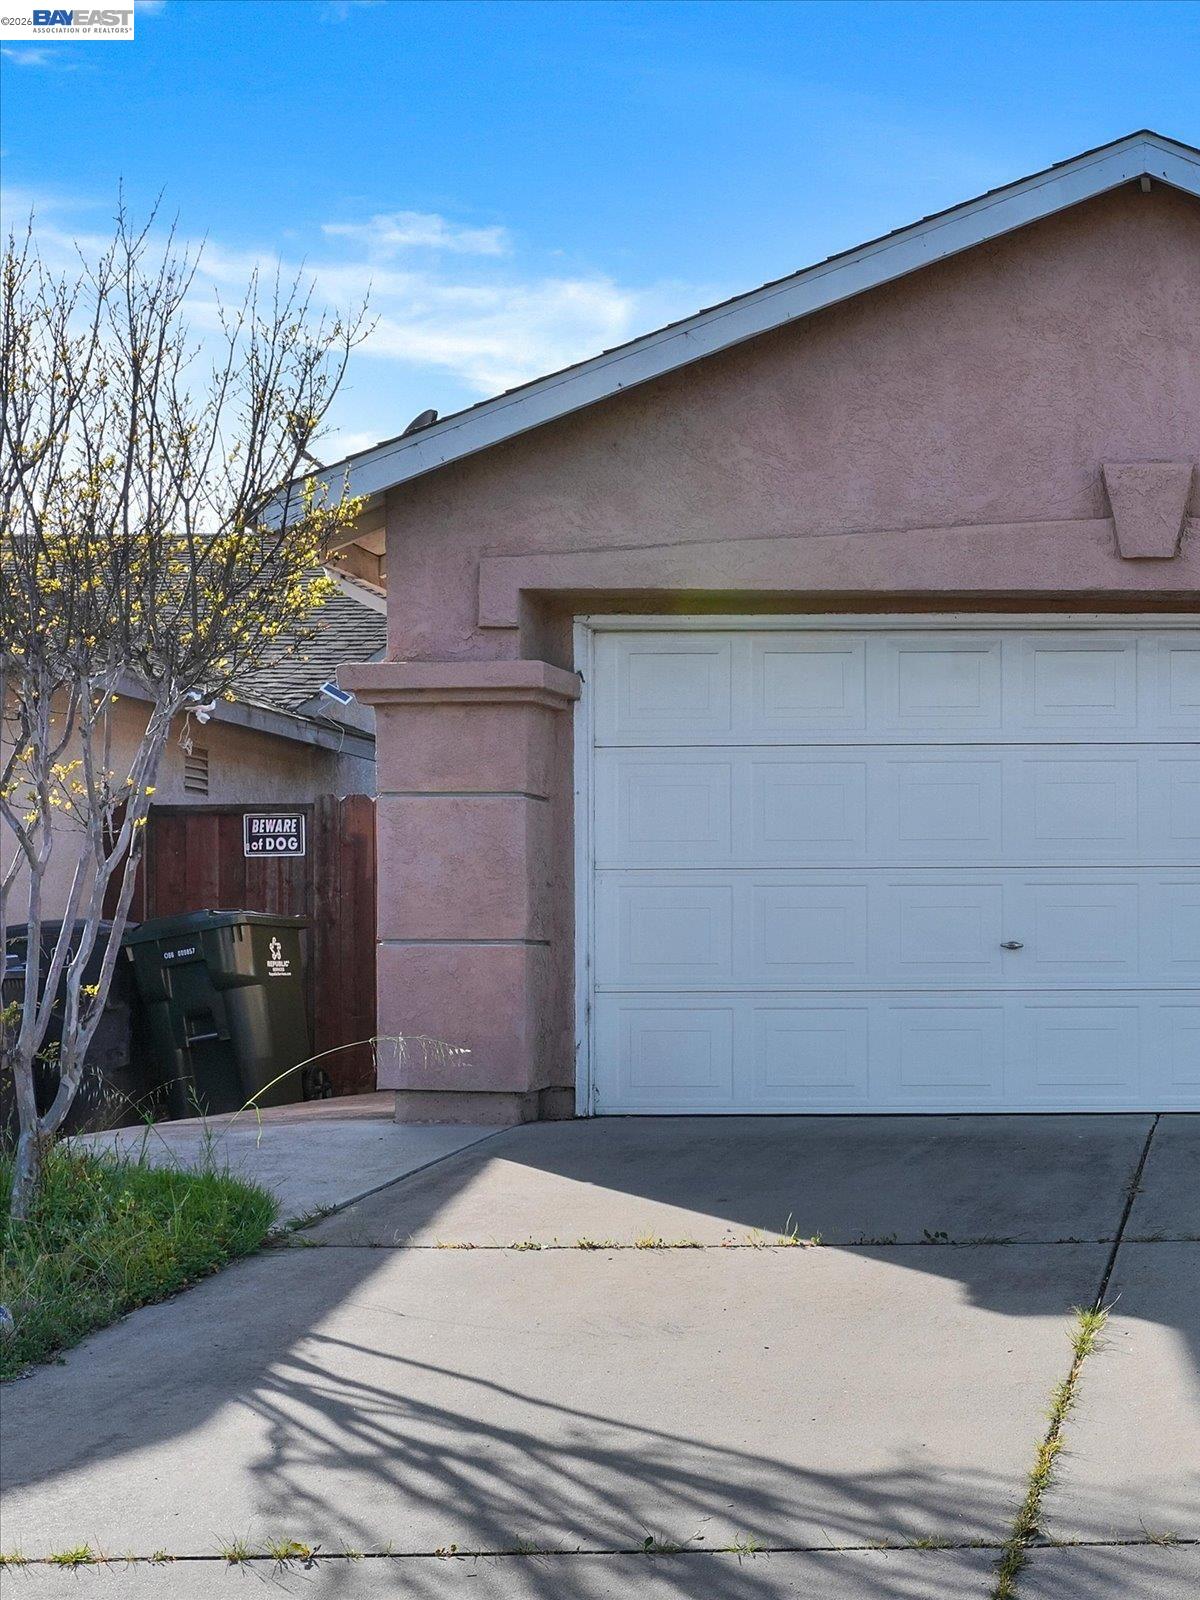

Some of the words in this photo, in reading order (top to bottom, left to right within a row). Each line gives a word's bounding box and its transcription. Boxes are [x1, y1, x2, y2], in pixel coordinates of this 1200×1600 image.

[252, 818, 297, 833] BEWARE
[251, 838, 263, 850] of
[265, 836, 298, 850] DOG
